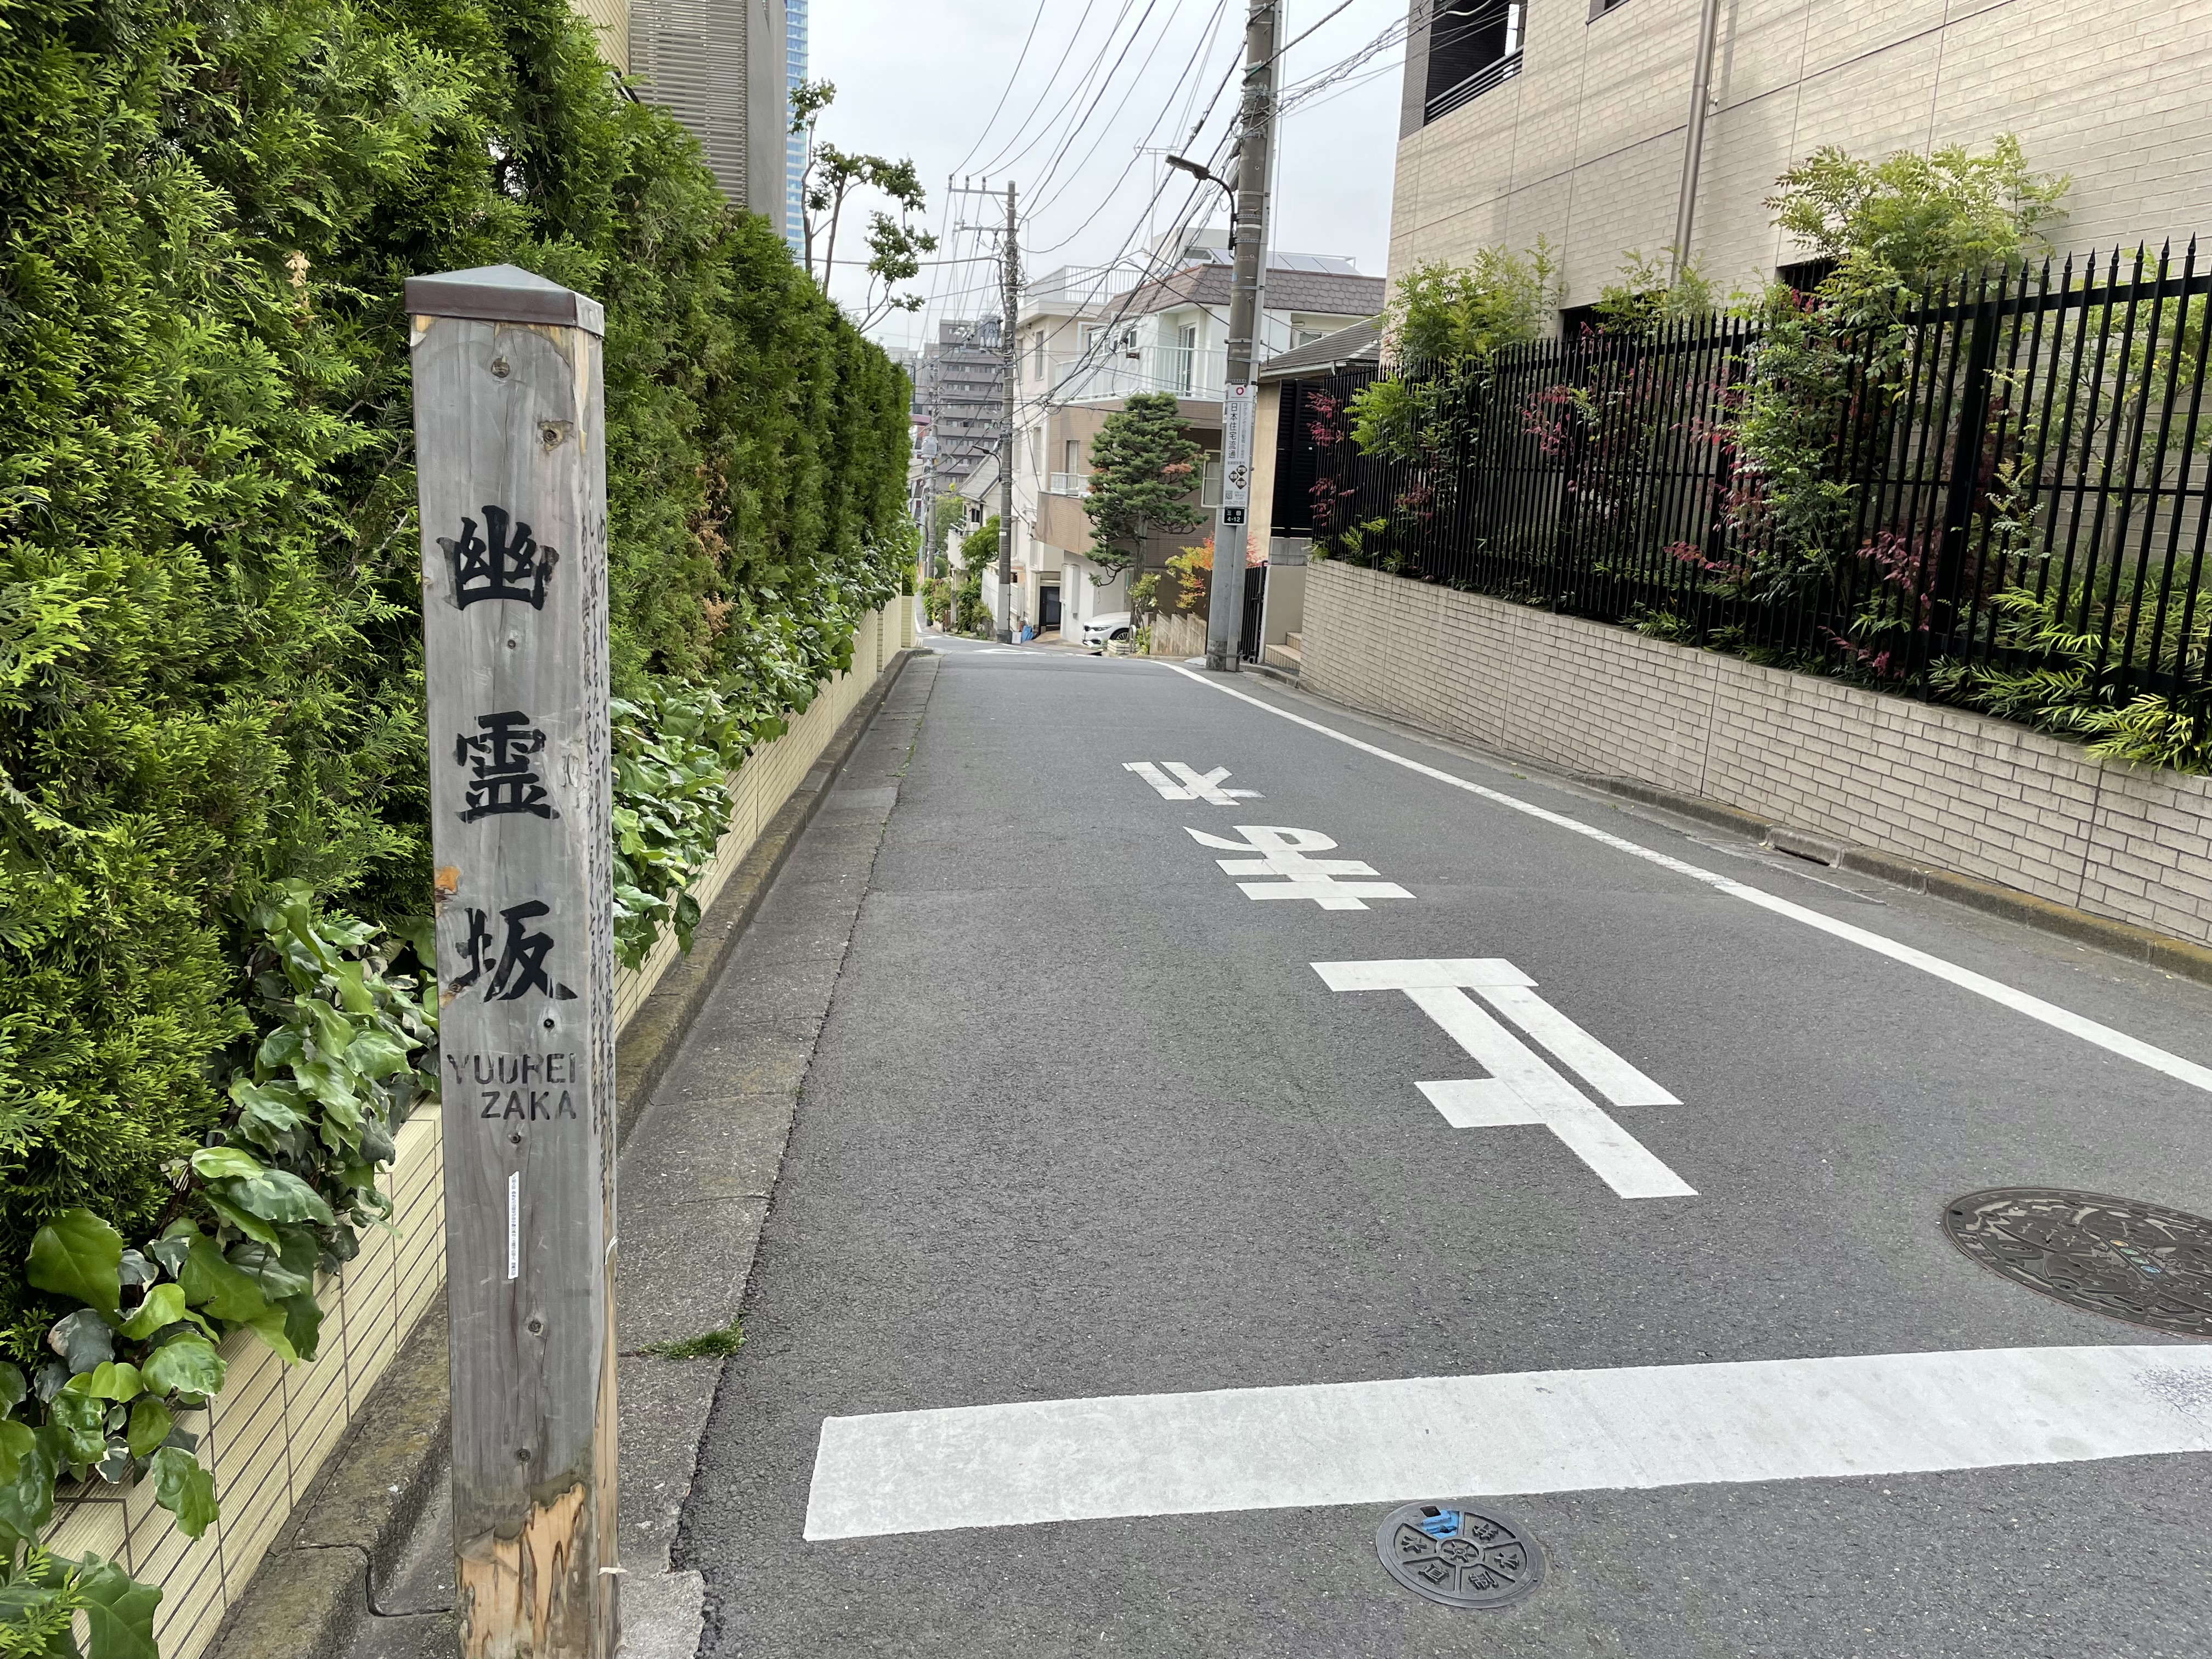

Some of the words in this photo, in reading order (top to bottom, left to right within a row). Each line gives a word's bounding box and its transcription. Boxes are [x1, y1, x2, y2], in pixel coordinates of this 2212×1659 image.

[1228, 403, 1238, 459] 日本住宅流通
[437, 505, 579, 1003] 幽霊坂
[1121, 761, 1700, 1199] 止まれ
[447, 1052, 576, 1085] YUUREI
[481, 1090, 577, 1121] ZAKA
